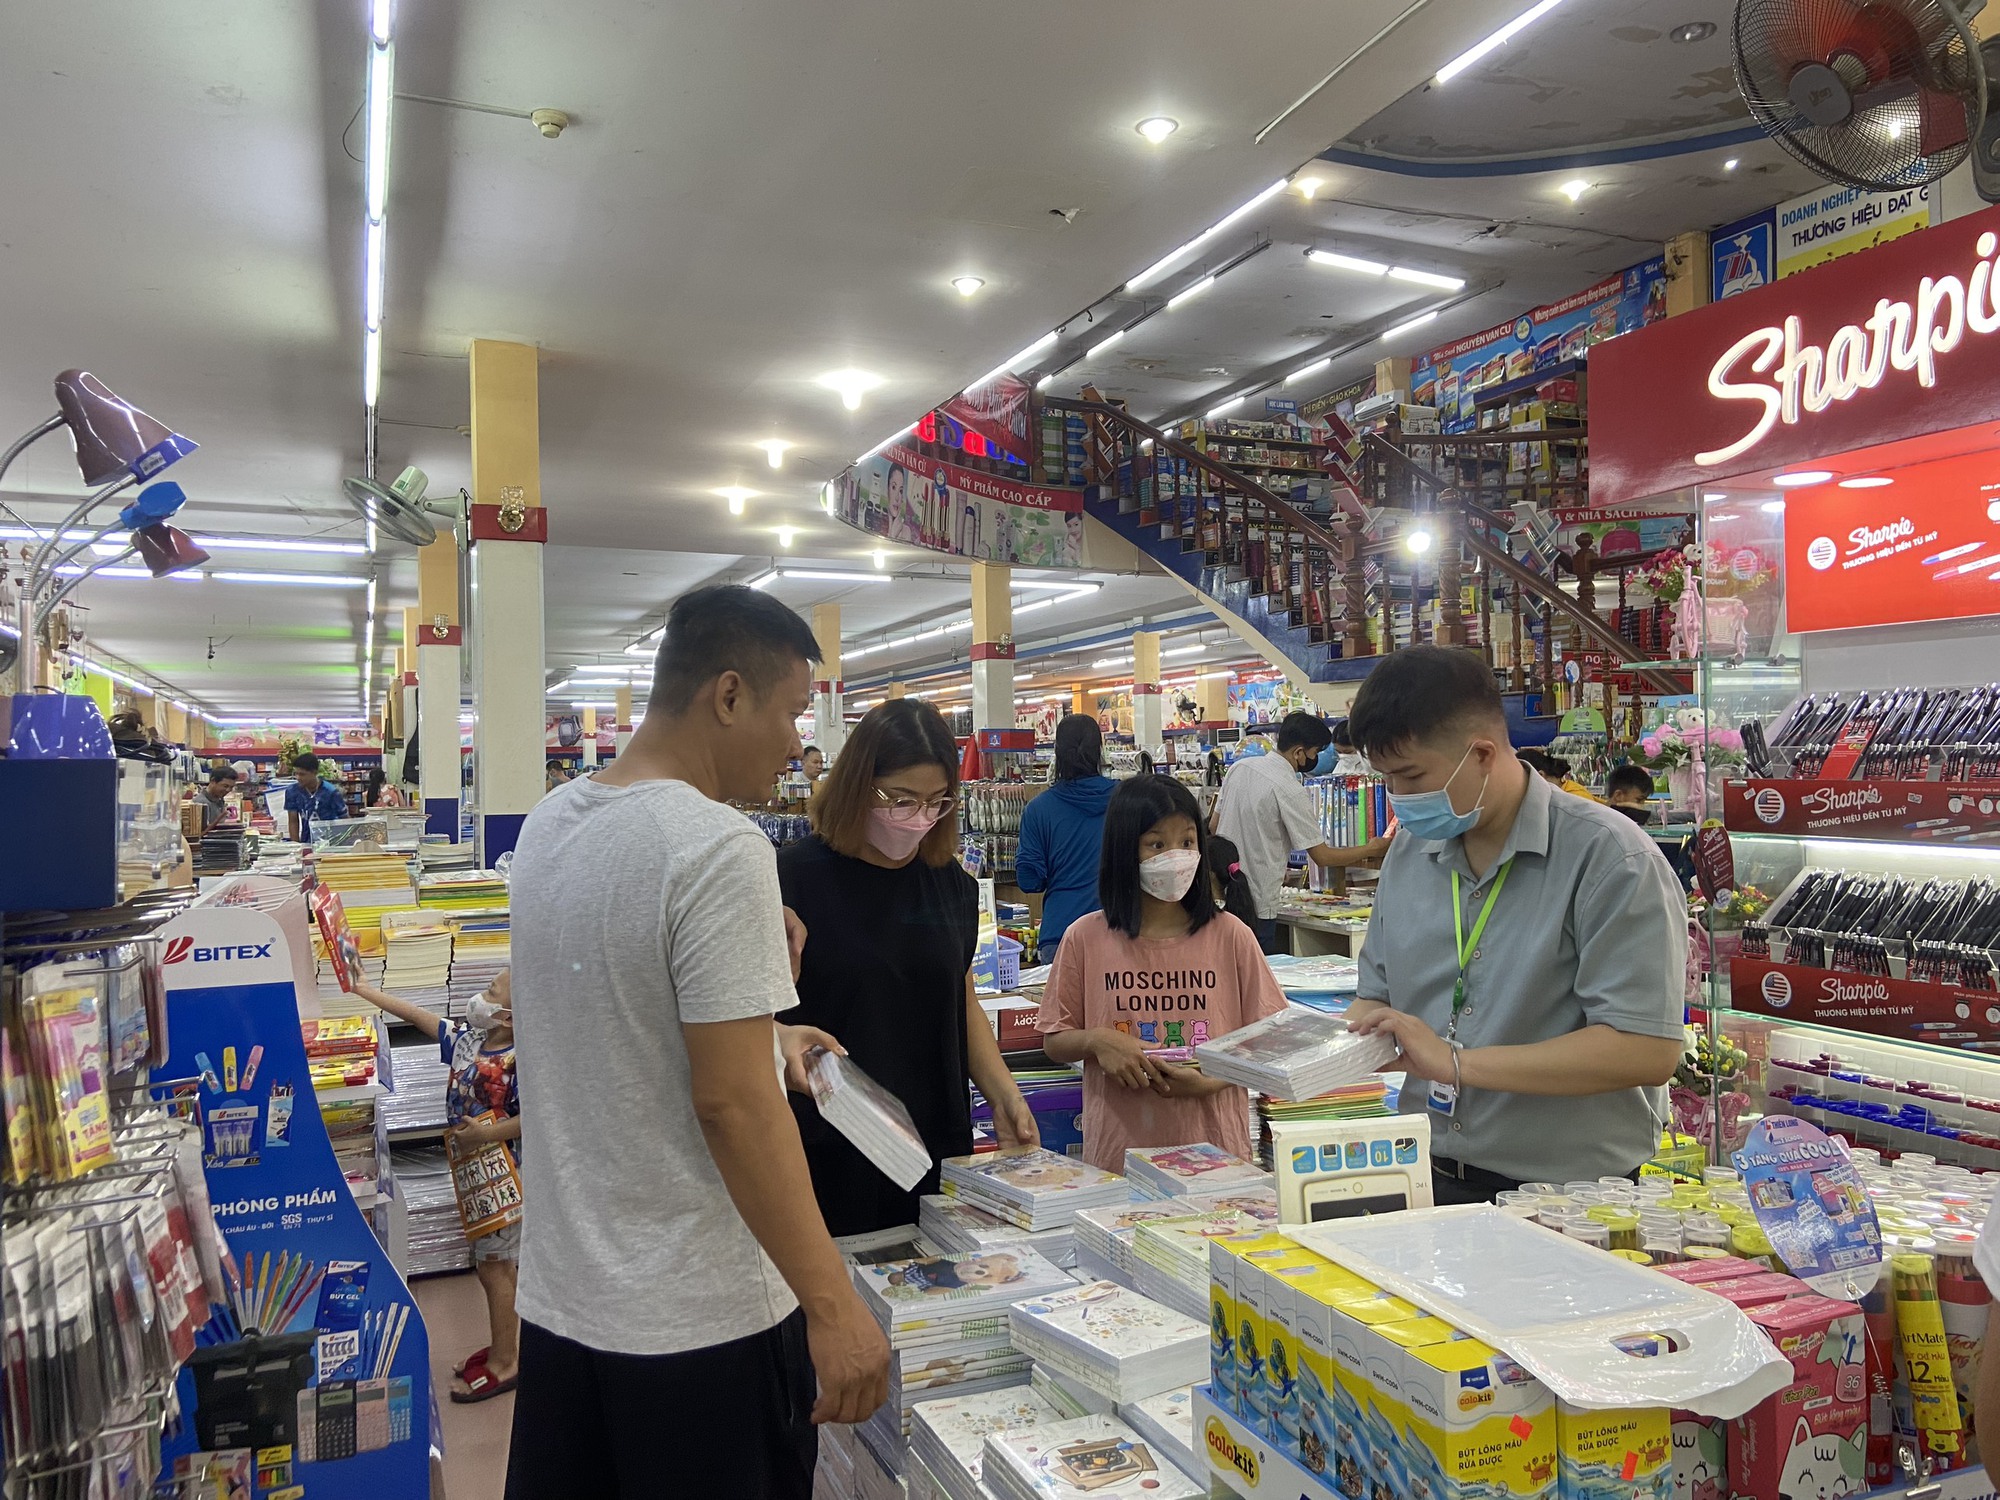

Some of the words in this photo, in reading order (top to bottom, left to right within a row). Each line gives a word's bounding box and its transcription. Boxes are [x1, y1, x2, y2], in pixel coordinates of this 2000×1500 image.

[1782, 202, 1817, 228] DOANH
[1792, 217, 1846, 247] THƯƠNG
[1851, 203, 1882, 227] HIỆU
[1888, 191, 1913, 214] ĐẠT
[1695, 232, 2000, 465] Sharpi
[1344, 385, 1361, 398] KHOA
[960, 471, 972, 488] MỸ
[974, 481, 999, 498] PHẨM
[1002, 489, 1022, 503] CAO
[1026, 491, 1052, 506] CẤP
[1565, 512, 1575, 521] &
[1845, 516, 1914, 556] Sharpie
[1842, 553, 1875, 570] THƯƠNG
[1876, 545, 1894, 561] HIỆU
[1896, 538, 1912, 553] ĐẾN
[1913, 535, 1924, 548] TỪ
[1925, 530, 1938, 544] MỸ
[1810, 784, 1882, 813] Sharpie
[1807, 817, 1841, 829] THƯƠNG
[1842, 813, 1861, 825] HIỆU
[1862, 808, 1880, 822] ĐẾN
[1881, 807, 1892, 818] TỪ
[1894, 804, 1907, 816] MỸ
[193, 943, 271, 962] BITEX
[1105, 970, 1216, 991] MOSCHINO
[1116, 994, 1206, 1012] LONDON
[1817, 978, 1889, 1008] Sharpie
[1814, 1007, 1849, 1018] THƯƠNG
[1850, 1006, 1868, 1018] HIỆU
[1869, 1004, 1887, 1016] ĐẾN
[1888, 1004, 1899, 1015] TỪ
[1901, 1004, 1914, 1014] MỸ
[1735, 1153, 1749, 1170] 3
[1800, 1140, 1842, 1160] COOL
[211, 1196, 279, 1217] PHÒNG
[284, 1187, 336, 1209] PHẨM
[225, 1225, 245, 1235] CHÂU
[246, 1223, 257, 1233] ÂU
[261, 1221, 274, 1231] BỞI
[281, 1213, 302, 1224] SGS
[1372, 1370, 1398, 1390] SWM-C006
[1907, 1360, 1932, 1383] 12
[1934, 1374, 1949, 1382] Màu
[1844, 1375, 1860, 1389] 36
[1411, 1395, 1439, 1417] SWM-C006
[1460, 1392, 1491, 1406] colokit
[1577, 1430, 1594, 1440] BÚT
[1596, 1426, 1618, 1437] LÔNG
[1620, 1421, 1637, 1432] MÀU
[1208, 1430, 1254, 1479] colokit
[1458, 1447, 1476, 1459] BÚT
[1478, 1443, 1502, 1455] LÔNG
[1504, 1439, 1522, 1450] MÀU
[1577, 1440, 1594, 1452] RỬA
[1596, 1437, 1619, 1448] ĐƯỢC
[1458, 1457, 1476, 1470] RỬA
[1479, 1455, 1503, 1466] ĐƯỢC
[1579, 1459, 1606, 1469] SWM-C006
[1460, 1478, 1489, 1489] SWM-C006
